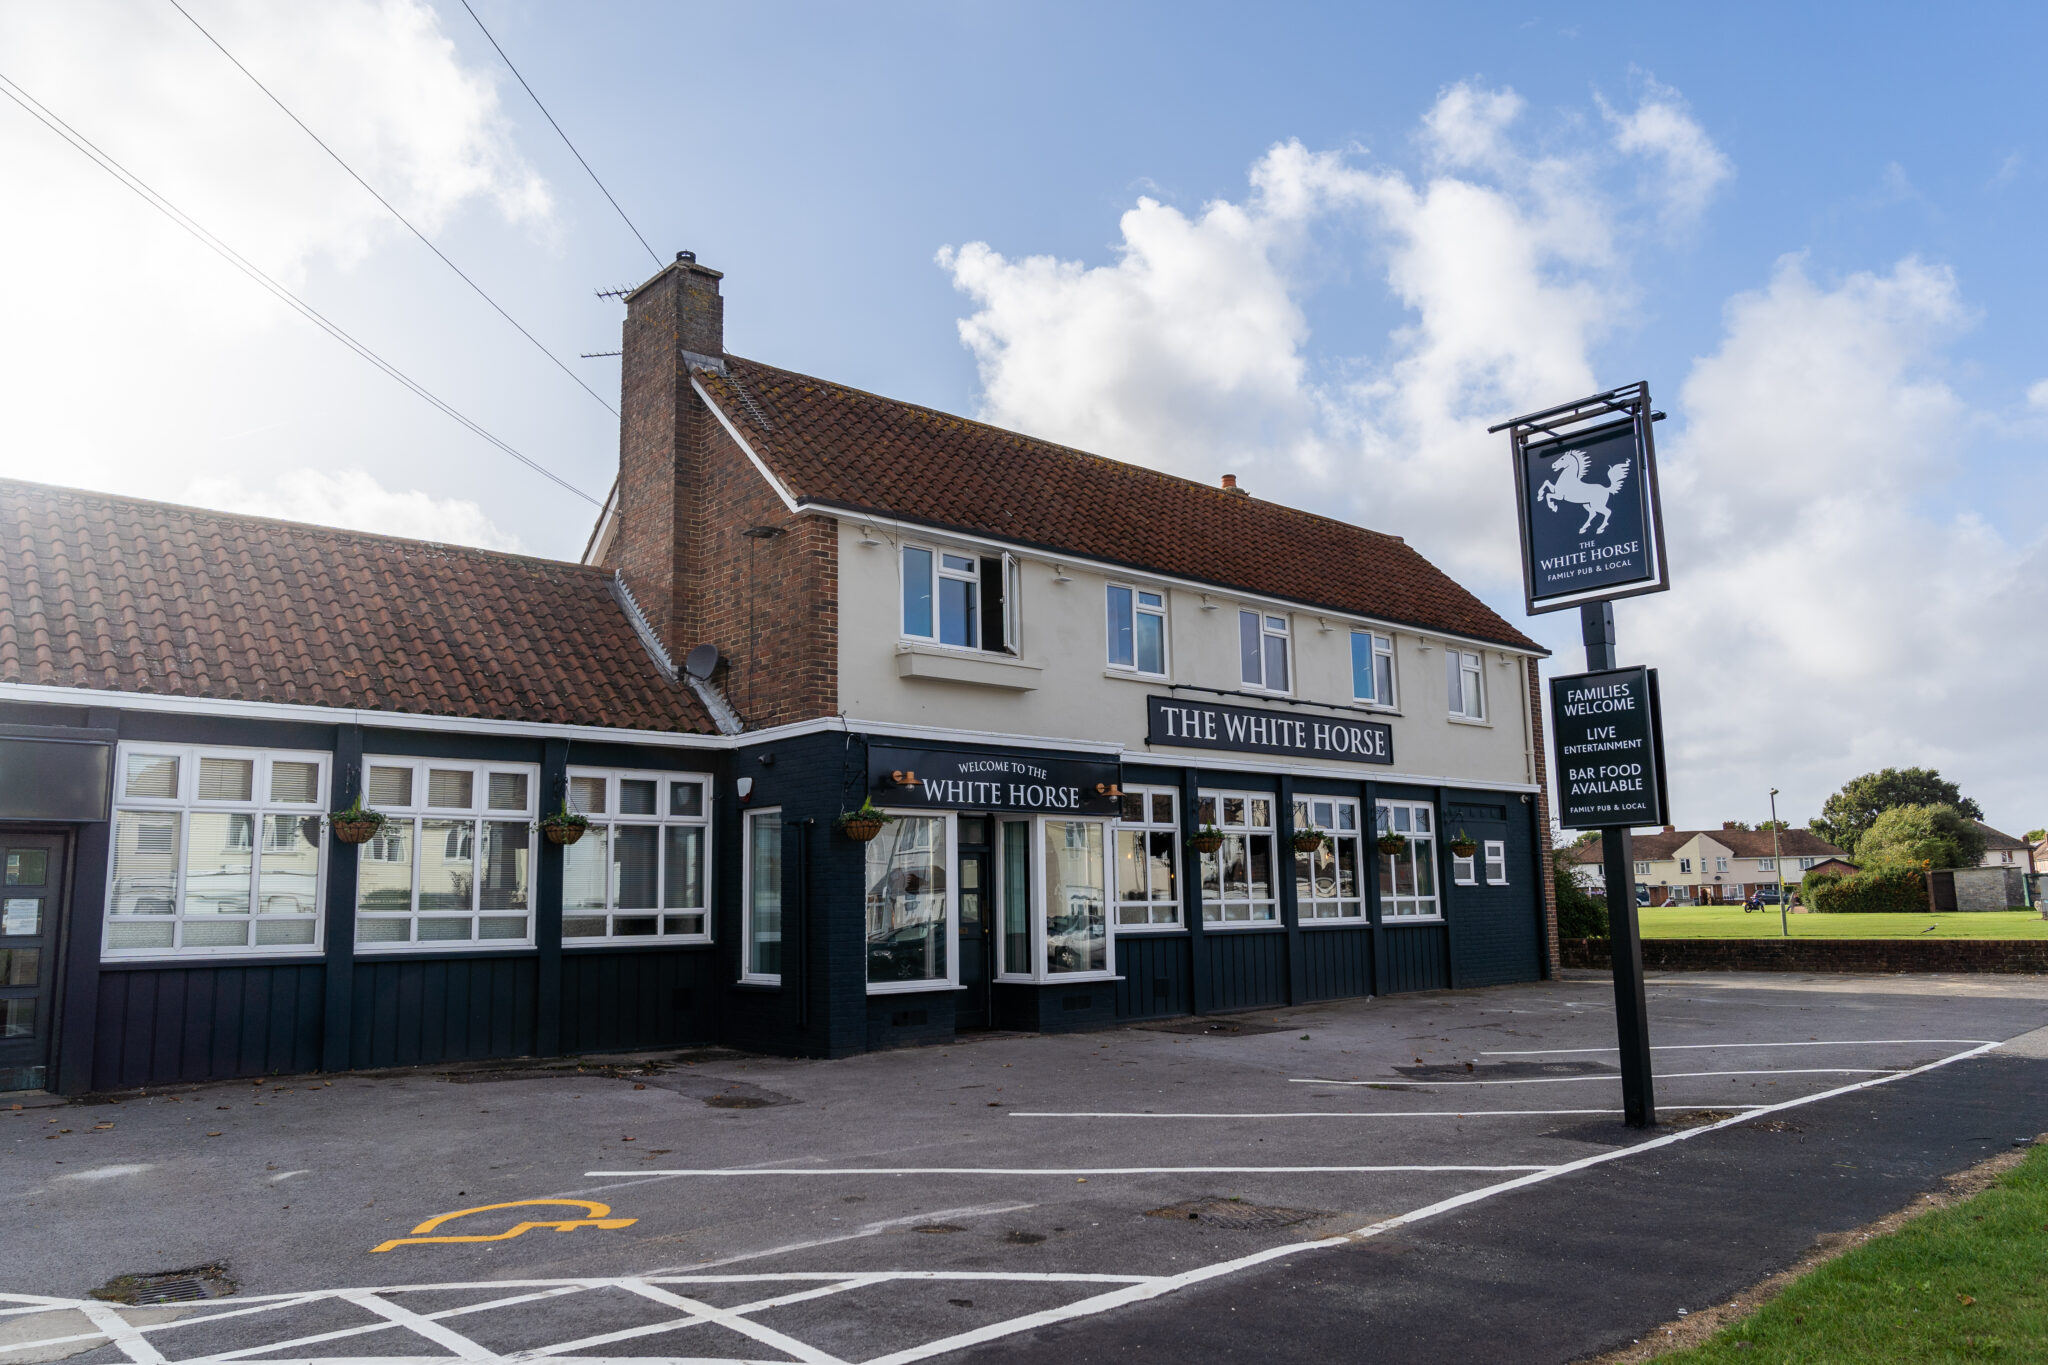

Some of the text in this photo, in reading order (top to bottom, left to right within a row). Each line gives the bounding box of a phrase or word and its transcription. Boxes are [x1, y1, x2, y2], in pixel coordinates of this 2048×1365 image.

[1579, 540, 1595, 550] THE
[1540, 540, 1639, 571] WHITE HORSE
[1547, 570, 1575, 582] FAMILY
[1577, 566, 1593, 576] PUB
[1605, 559, 1632, 571] LOCAL
[1567, 683, 1630, 702] FAMILIES
[1564, 697, 1635, 717] WELCOME
[1160, 706, 1386, 756] THE WHITE HORSE
[1586, 726, 1616, 741] LIVE
[1564, 739, 1643, 754] ENTERTAINMENT
[958, 760, 1047, 780] WELCOME TO THE
[1569, 763, 1642, 780] BAR FOOD
[921, 778, 1080, 808] WHITE HORSE
[1571, 778, 1643, 795] AVAILABLE
[1570, 805, 1595, 814] FAMILY
[1597, 804, 1612, 812] PUB
[1622, 802, 1647, 810] LOCAL
